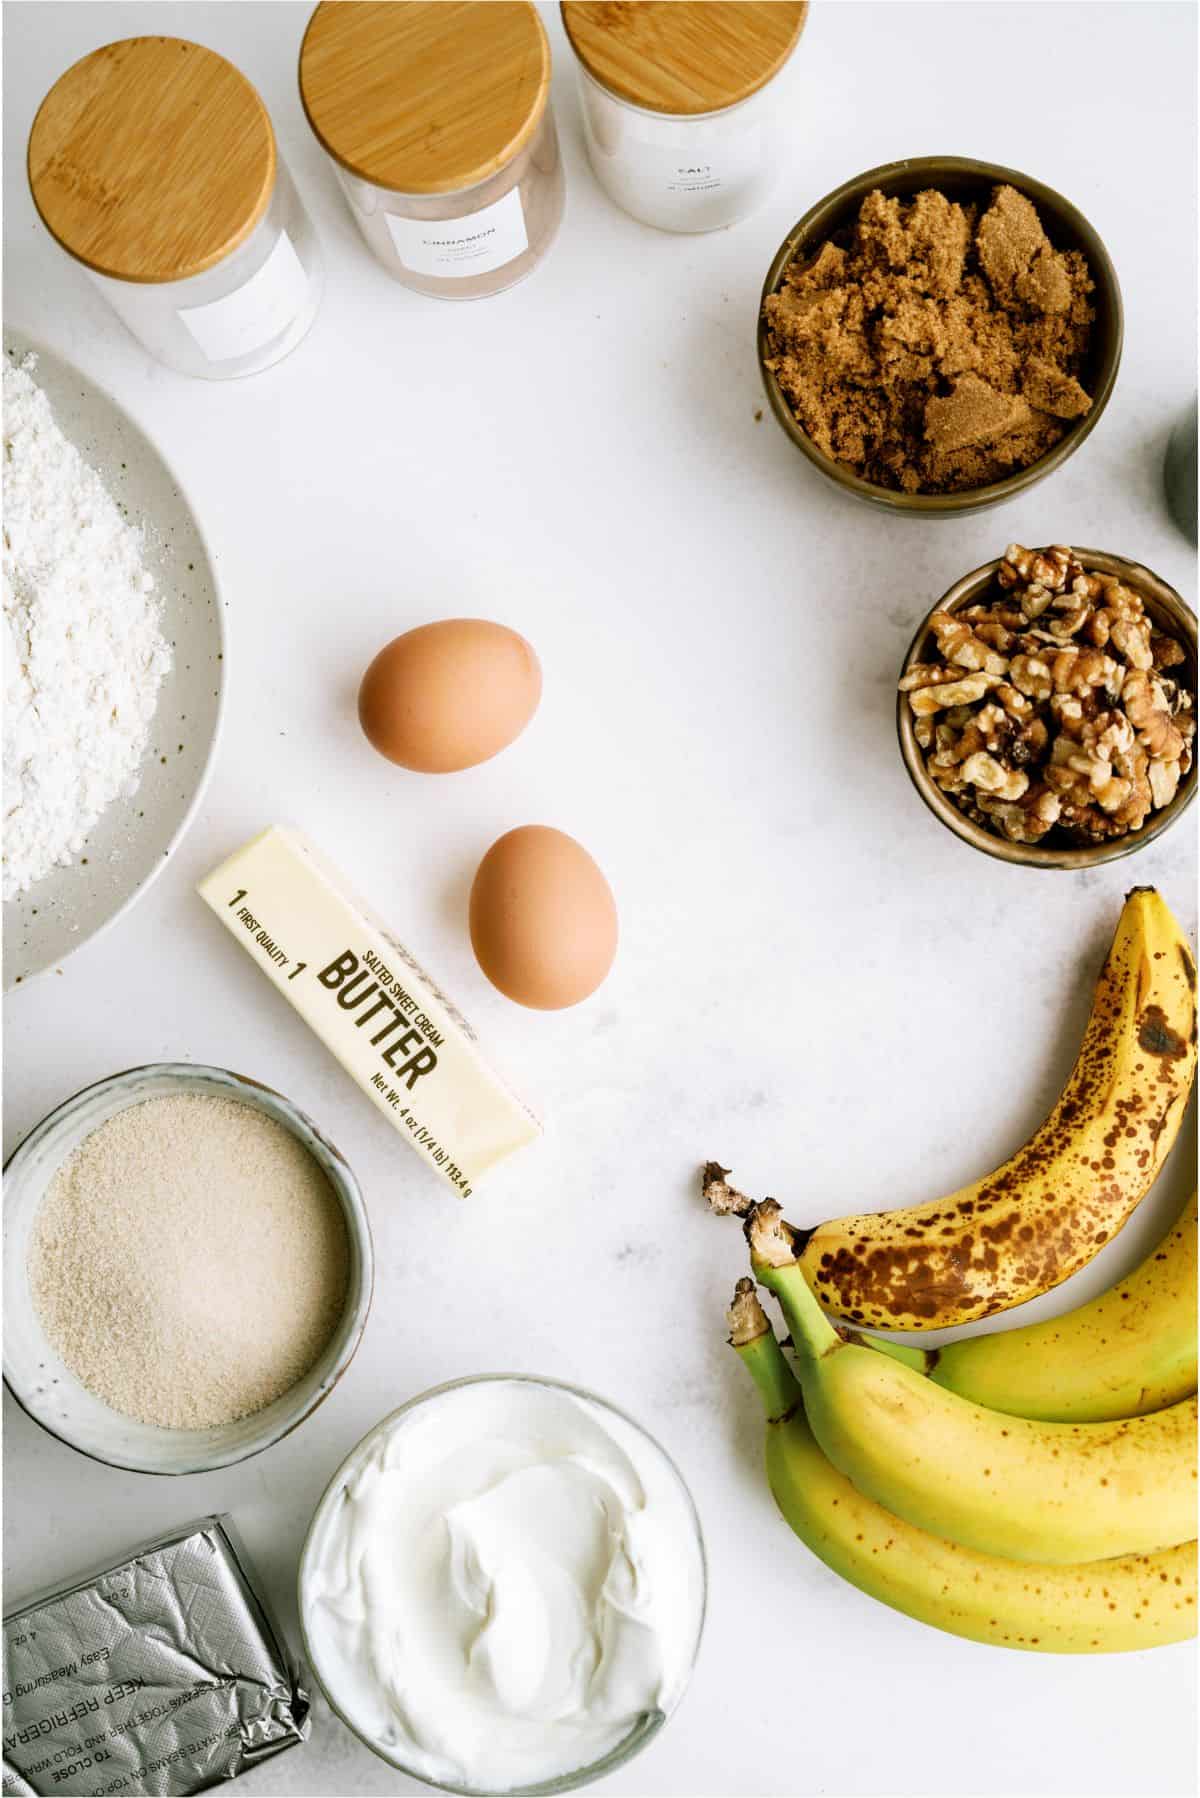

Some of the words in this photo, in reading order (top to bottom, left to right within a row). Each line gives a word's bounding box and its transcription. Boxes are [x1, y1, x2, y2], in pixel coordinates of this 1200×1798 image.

[422, 228, 496, 245] CINNAMON
[228, 889, 248, 907] 1
[236, 907, 261, 933] FIRST
[255, 930, 289, 968] QUALITY
[287, 962, 307, 980] 1
[362, 950, 394, 986] SALTED
[389, 983, 419, 1015] SWEET
[414, 1013, 445, 1048] CREAM
[316, 949, 439, 1090] BUTTER
[370, 1072, 388, 1092] Net
[385, 1089, 400, 1110] Wt.
[399, 1108, 410, 1117] 4
[405, 1116, 418, 1129] oz
[445, 1163, 469, 1189] 113.4
[80, 1647, 110, 1667] Easy
[15, 1662, 78, 1697] Measuring
[104, 1676, 146, 1704] KEEP
[110, 1704, 168, 1737] TOGETHER
[54, 1744, 83, 1763] FOLD
[84, 1733, 106, 1749] AND
[94, 1749, 112, 1762] TO
[149, 1748, 187, 1773] SEAMS
[51, 1757, 93, 1783] CLOSE
[130, 1766, 148, 1781] ON
[107, 1777, 130, 1793] TOP
